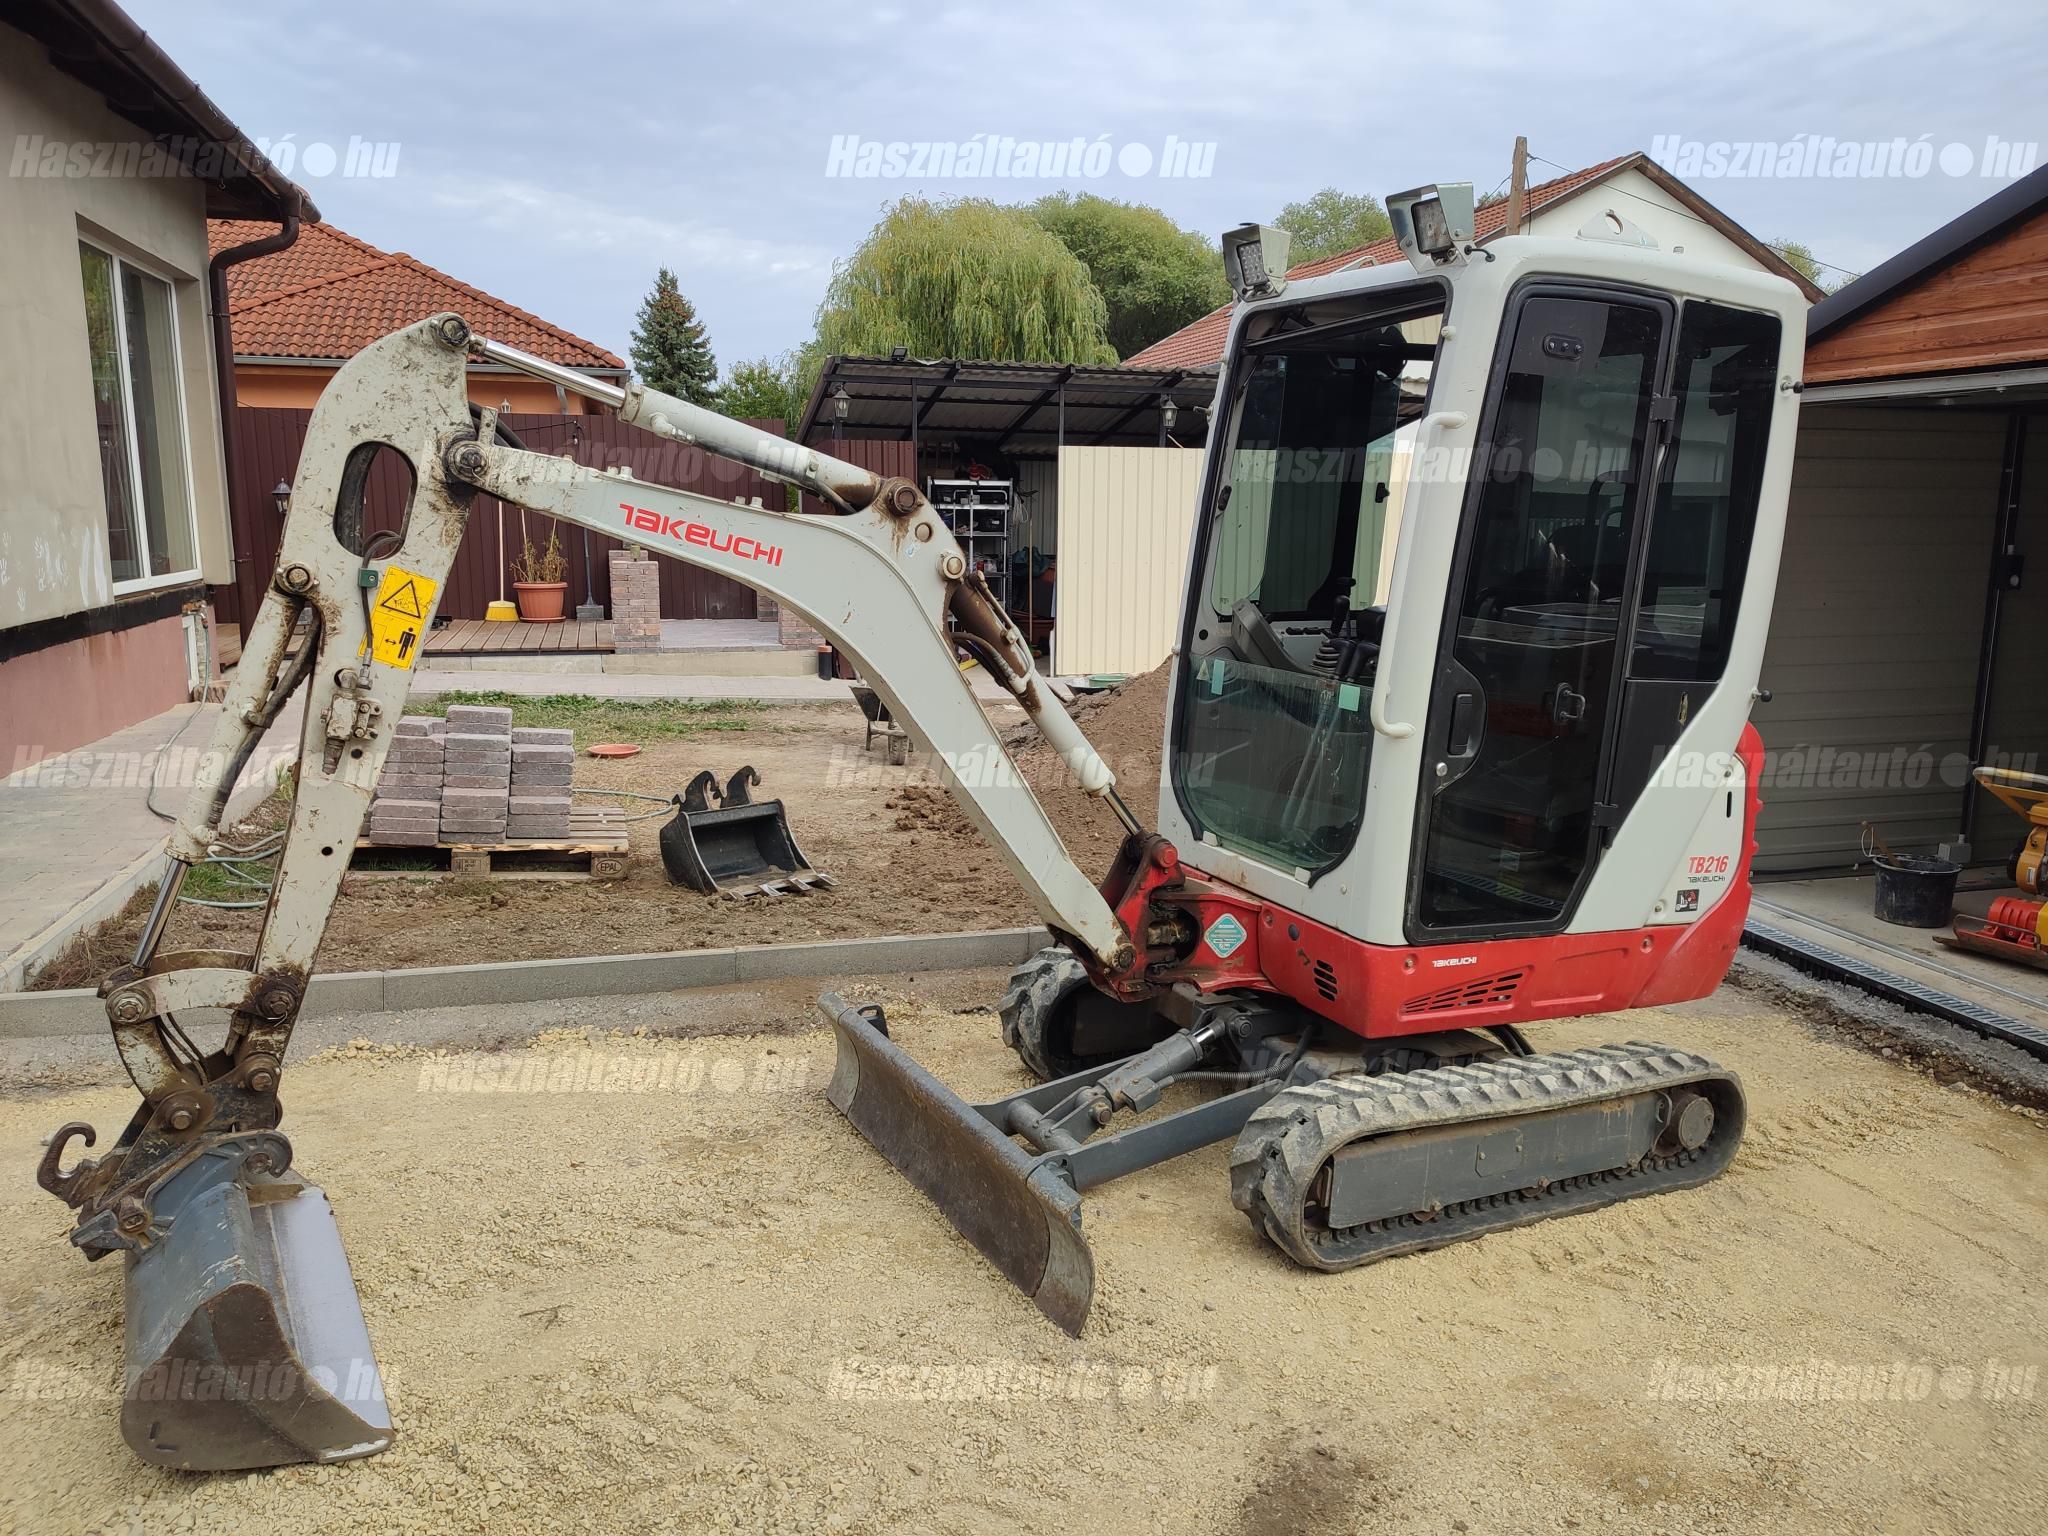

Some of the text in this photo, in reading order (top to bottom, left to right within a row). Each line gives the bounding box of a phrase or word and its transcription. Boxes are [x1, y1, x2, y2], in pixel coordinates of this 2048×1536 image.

[619, 503, 783, 567] TAKEUCHI
[600, 862, 619, 872] EPAL
[1688, 855, 1729, 874] TB216
